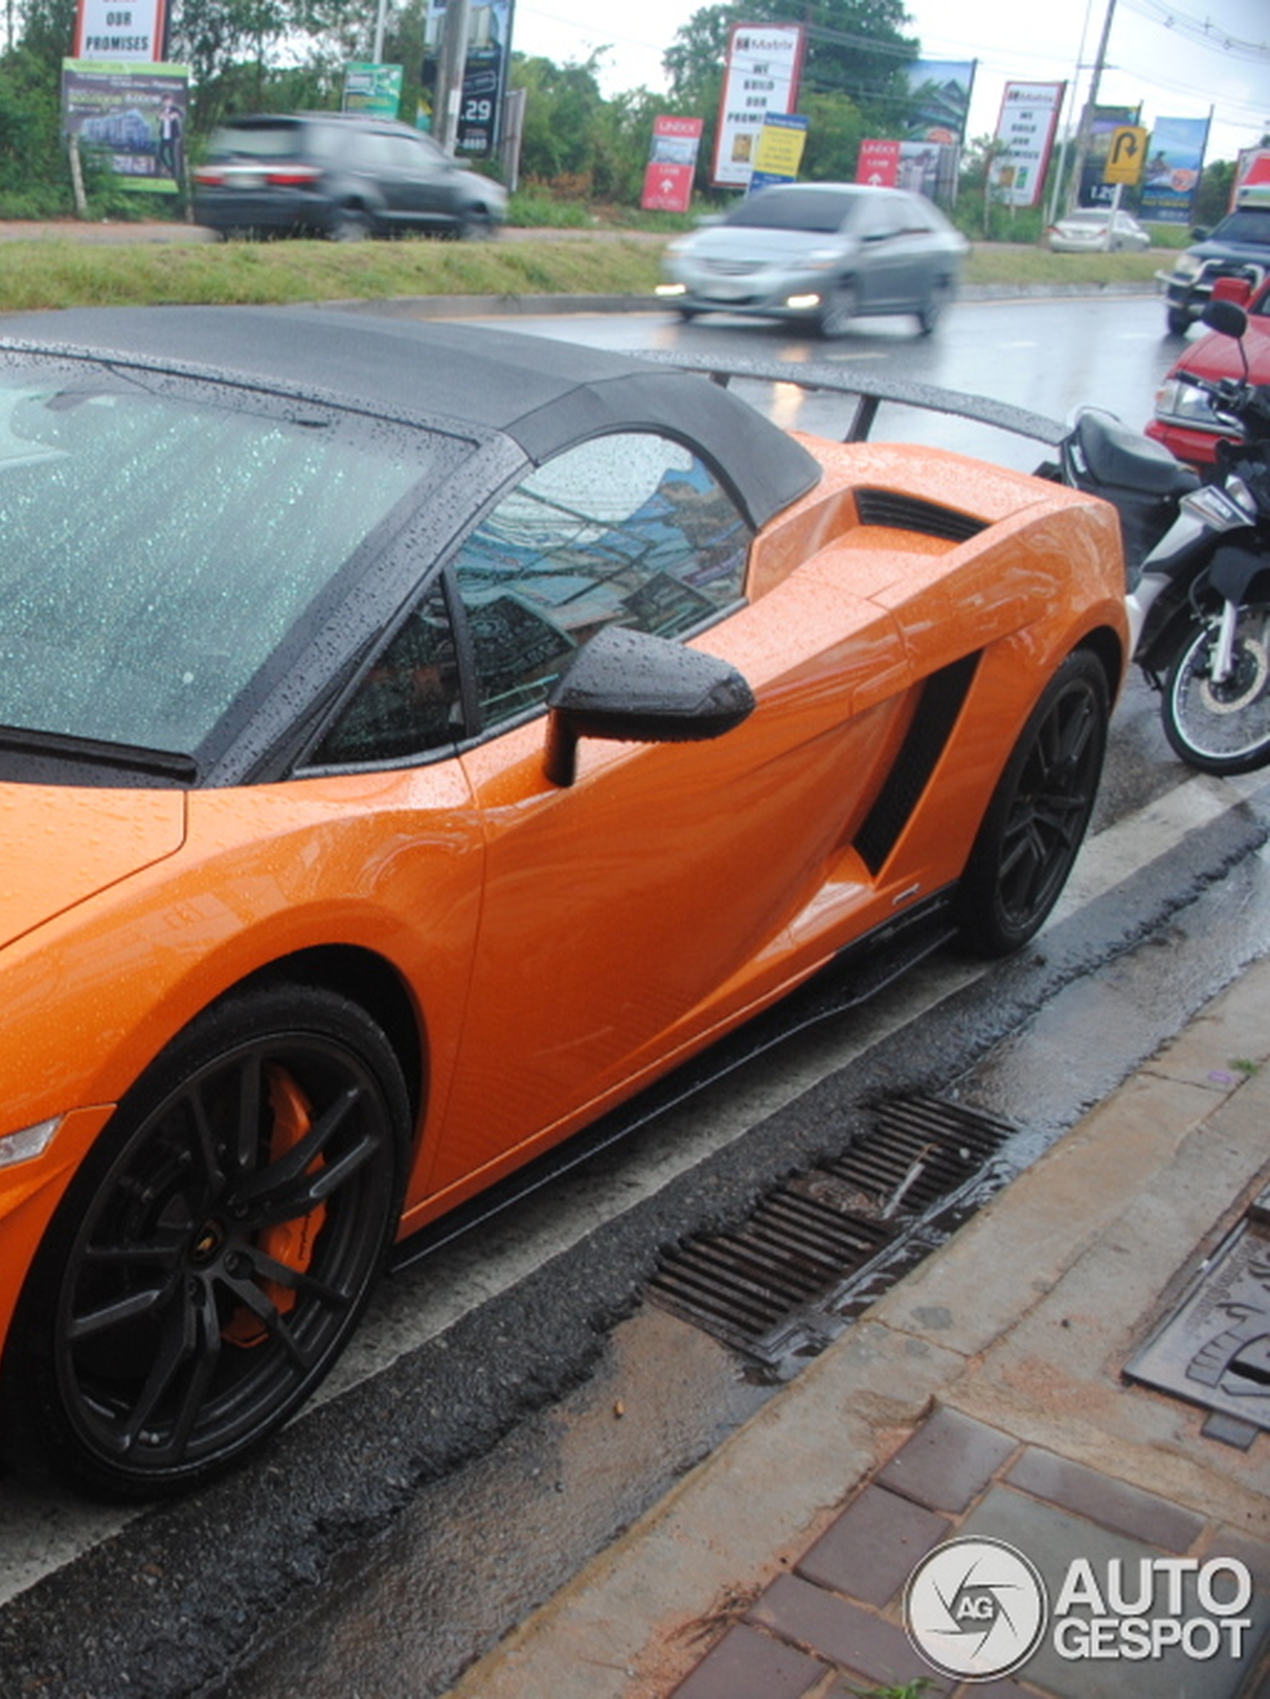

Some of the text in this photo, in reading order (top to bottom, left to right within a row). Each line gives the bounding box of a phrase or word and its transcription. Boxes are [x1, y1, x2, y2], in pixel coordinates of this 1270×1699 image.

[106, 11, 132, 27] OUR
[86, 36, 149, 51] PROMISES
[461, 100, 491, 121] .29
